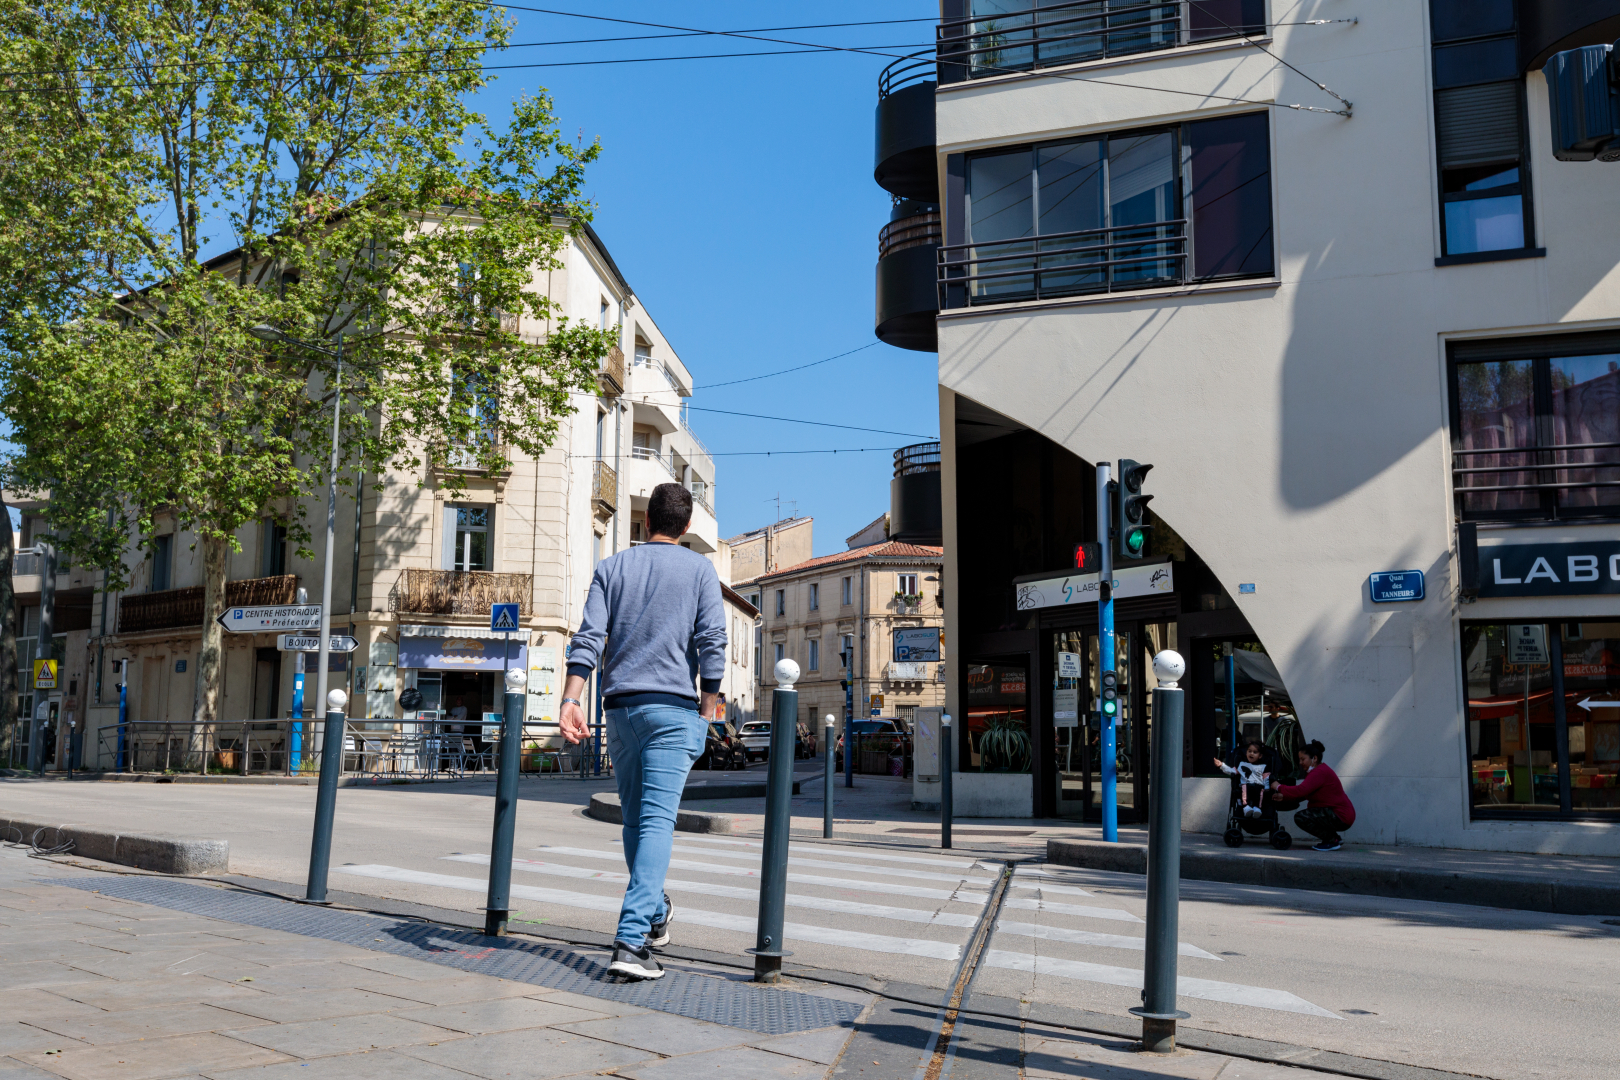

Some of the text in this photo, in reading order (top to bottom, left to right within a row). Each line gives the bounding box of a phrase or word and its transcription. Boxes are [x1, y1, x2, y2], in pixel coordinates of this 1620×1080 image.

[1389, 574, 1404, 582] Quai
[1076, 580, 1120, 592] LABOD
[1381, 590, 1415, 598] TANNEURS
[245, 609, 274, 618] CENTRE
[275, 607, 320, 617] HISTORIQUE
[272, 618, 320, 626] Préfecture
[288, 639, 341, 648] BOUTOET
